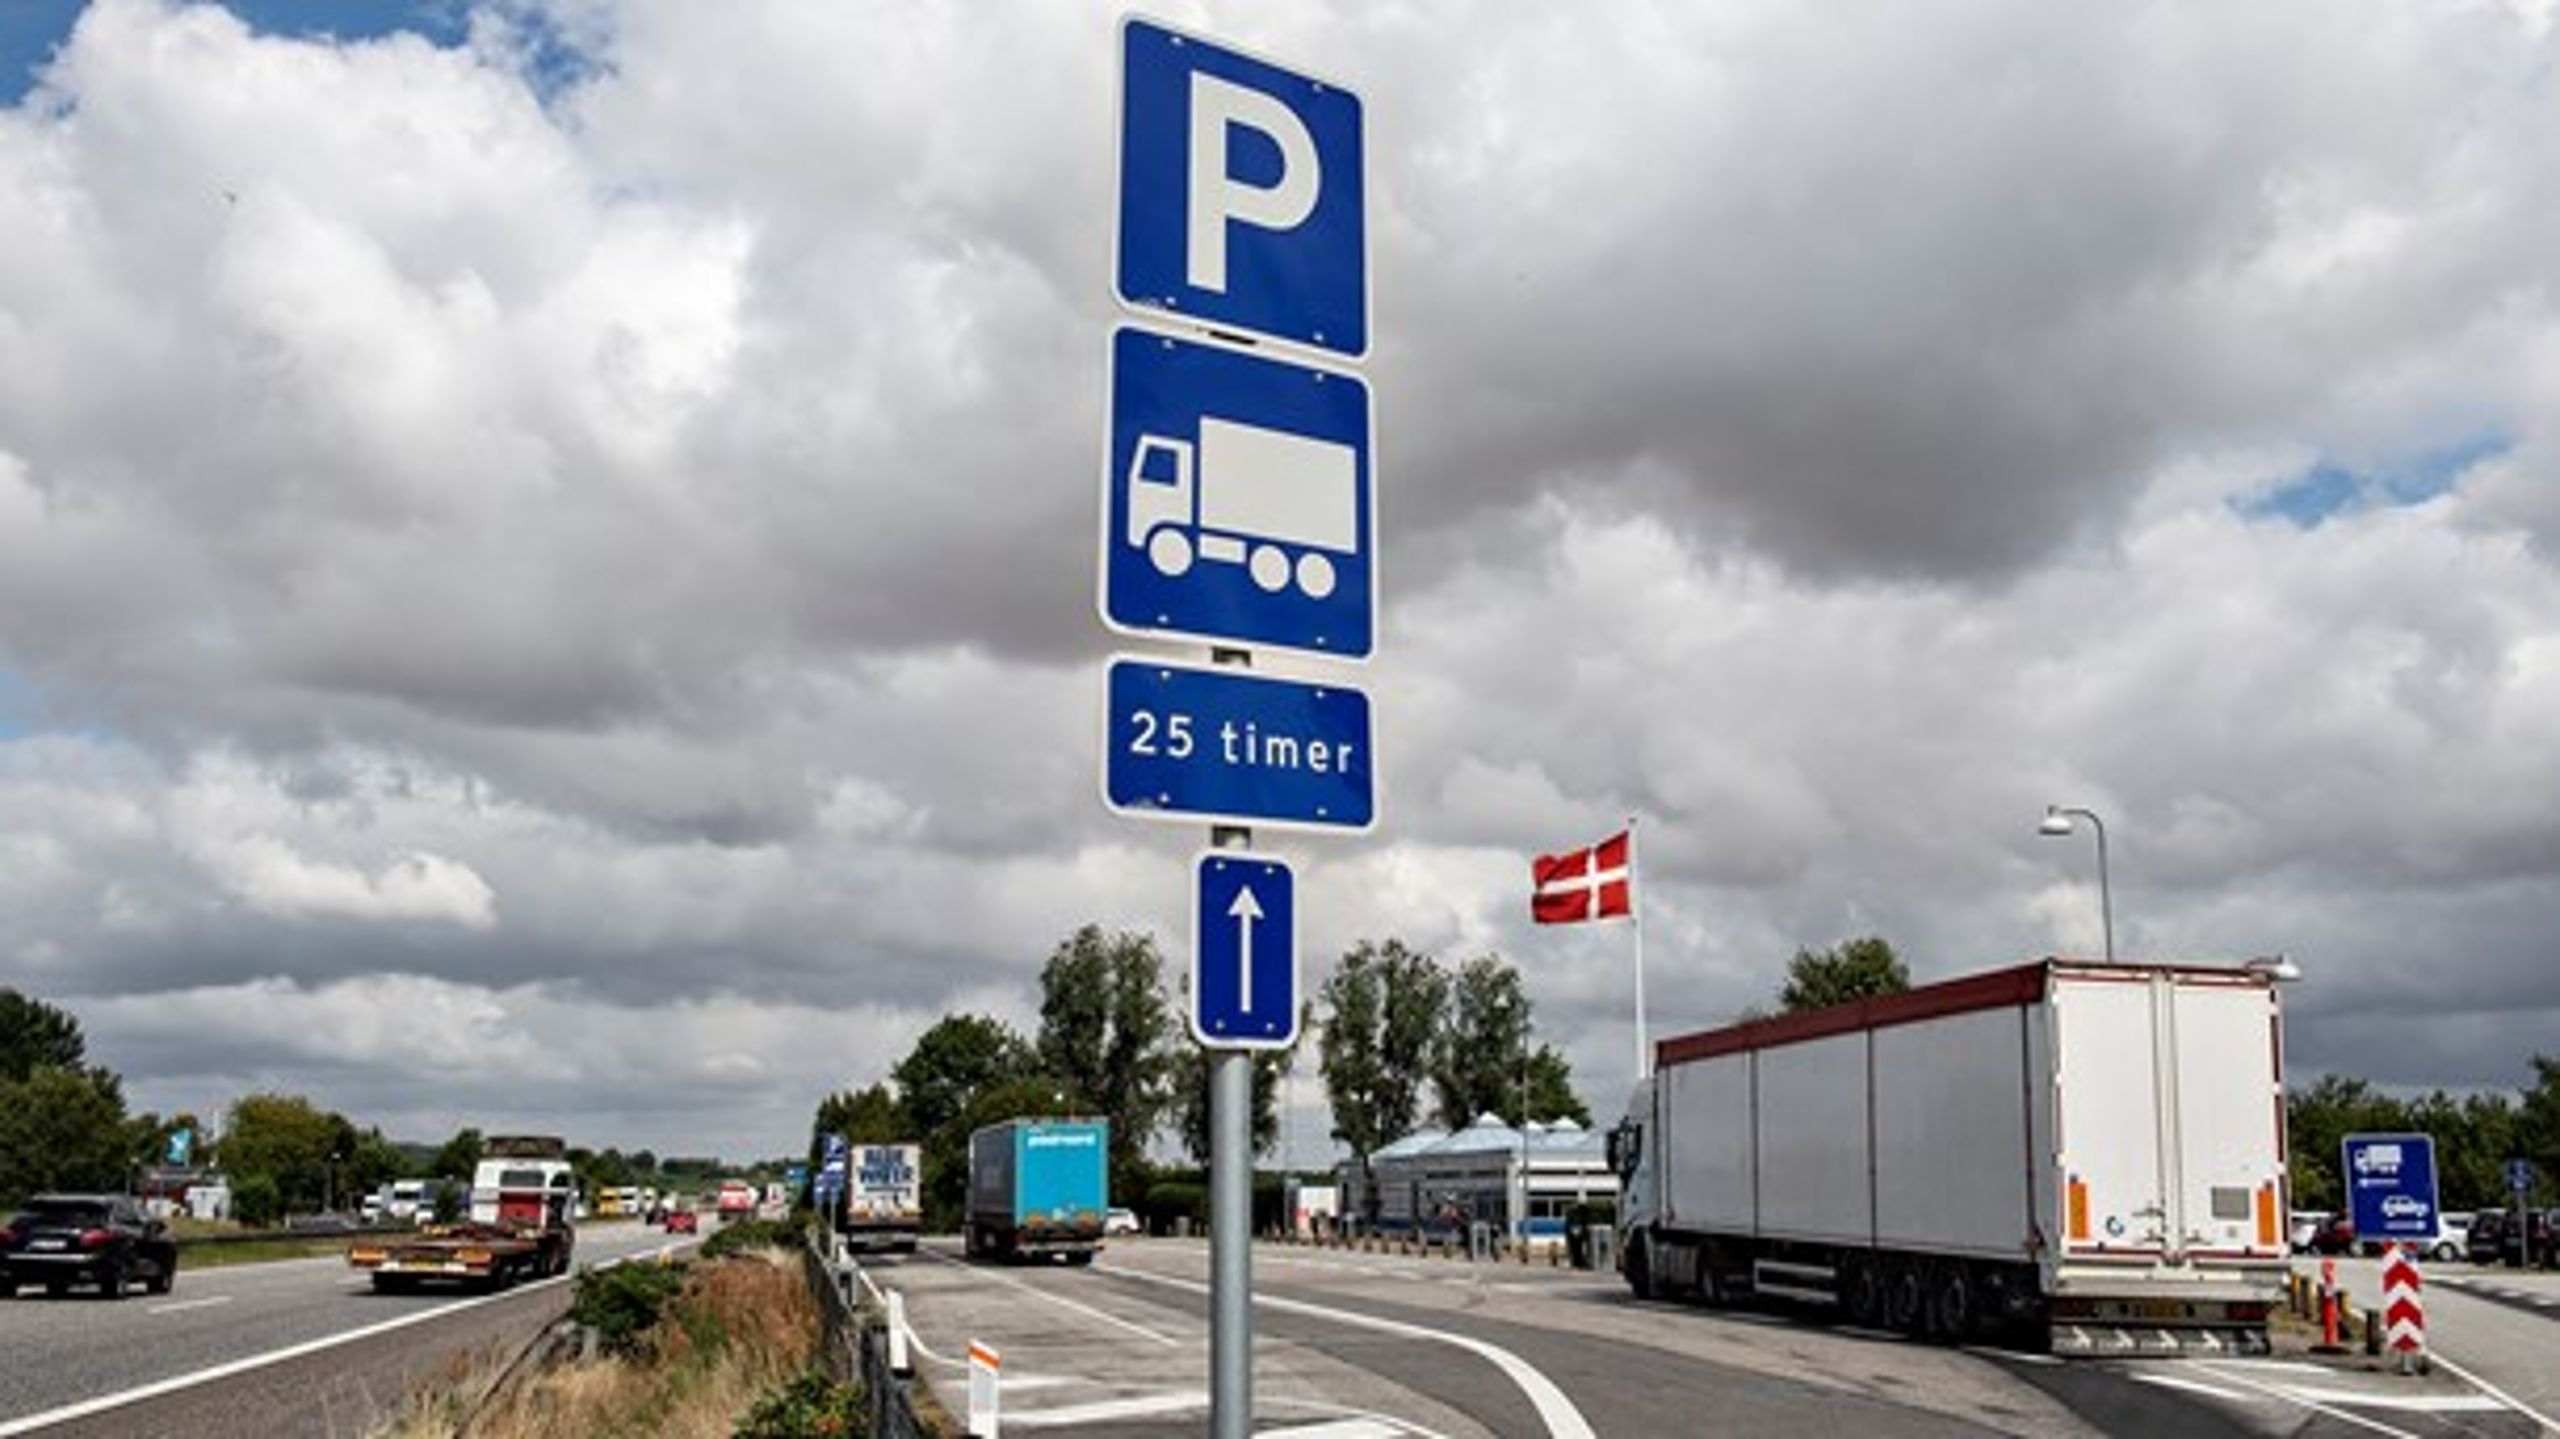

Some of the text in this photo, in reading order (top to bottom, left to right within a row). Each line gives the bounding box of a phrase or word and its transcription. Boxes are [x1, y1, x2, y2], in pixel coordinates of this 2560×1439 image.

[1187, 69, 1321, 294] P
[1131, 711, 1353, 774] 25 timer
